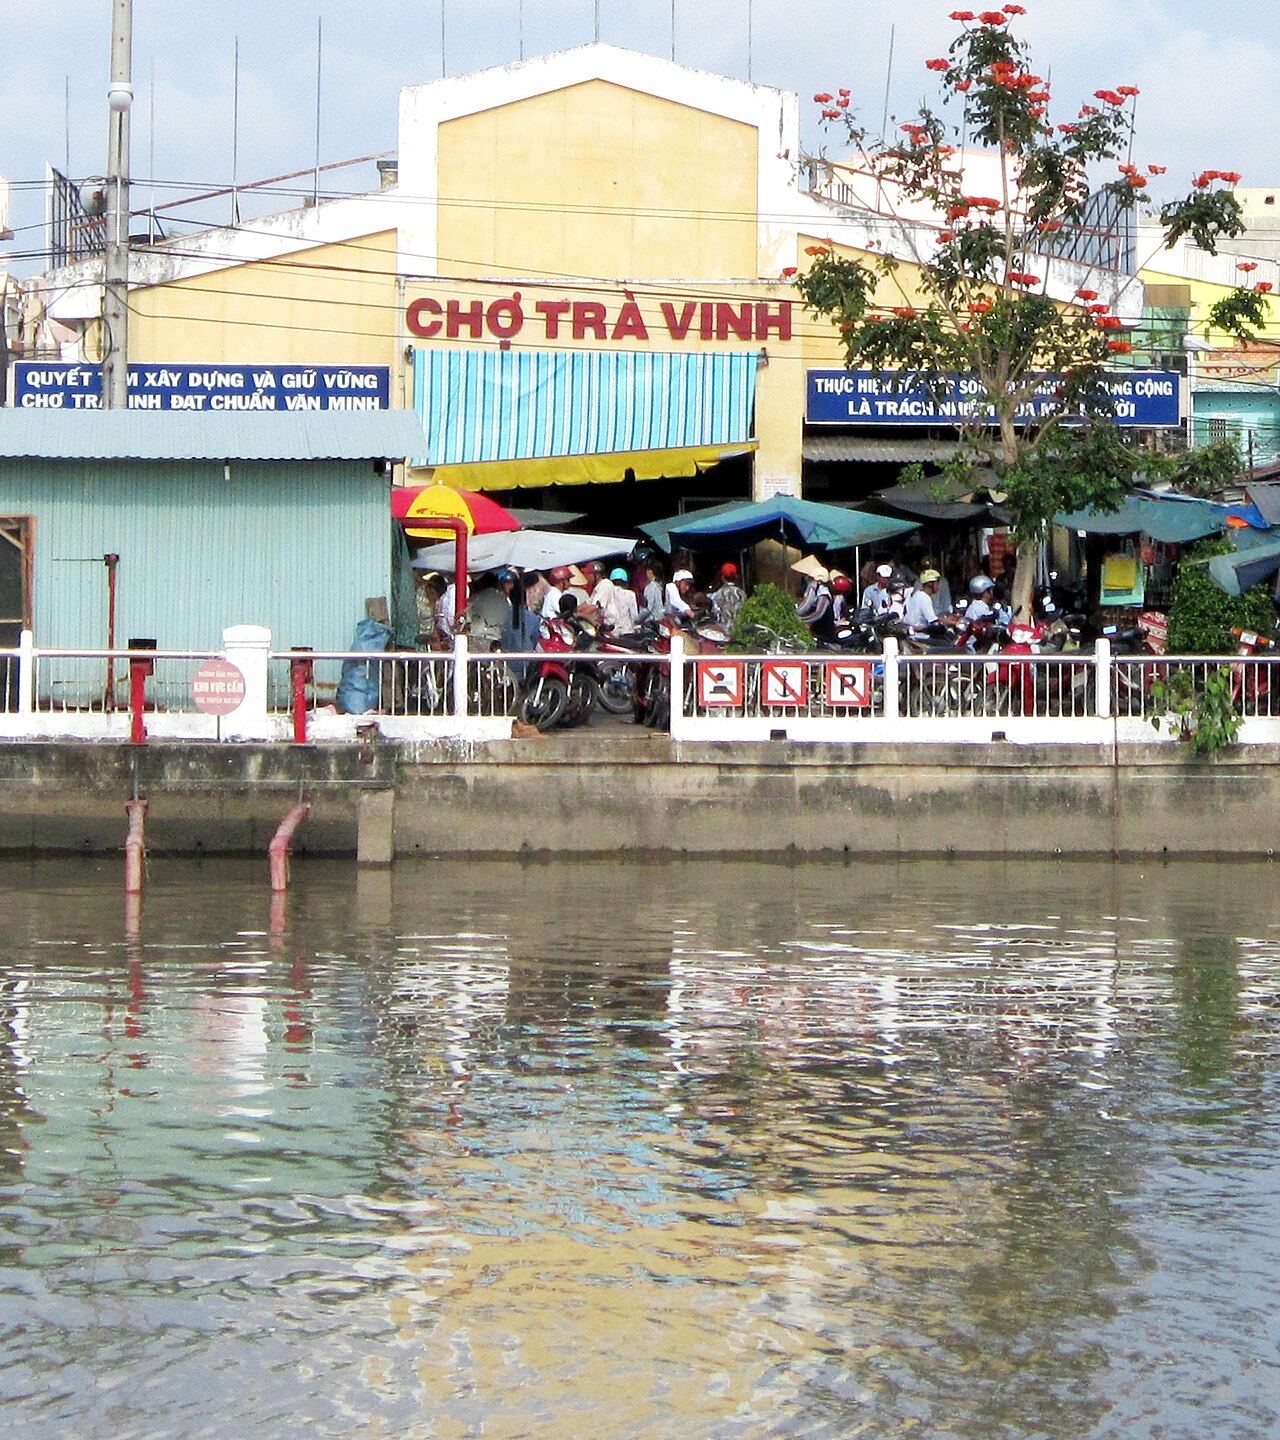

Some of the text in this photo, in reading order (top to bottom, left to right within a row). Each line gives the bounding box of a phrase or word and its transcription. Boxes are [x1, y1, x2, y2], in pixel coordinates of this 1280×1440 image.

[406, 288, 793, 350] CHỢ TRÀ VINH
[26, 366, 92, 388] QUYẾT
[144, 370, 185, 387] XÂY
[188, 371, 244, 391] DỰNG
[252, 371, 276, 388] VÀ
[281, 369, 317, 388] GIỮ
[323, 369, 378, 389] VỮNG
[815, 376, 854, 396] THỰC
[1135, 378, 1173, 398] CỘNG
[128, 394, 162, 409] INH
[210, 388, 276, 410] CHUẨN
[285, 392, 324, 410] VĂN
[328, 396, 380, 410] MINH
[848, 397, 871, 416] LÀ
[875, 397, 934, 416] TRÁCH
[193, 681, 209, 692] KHU
